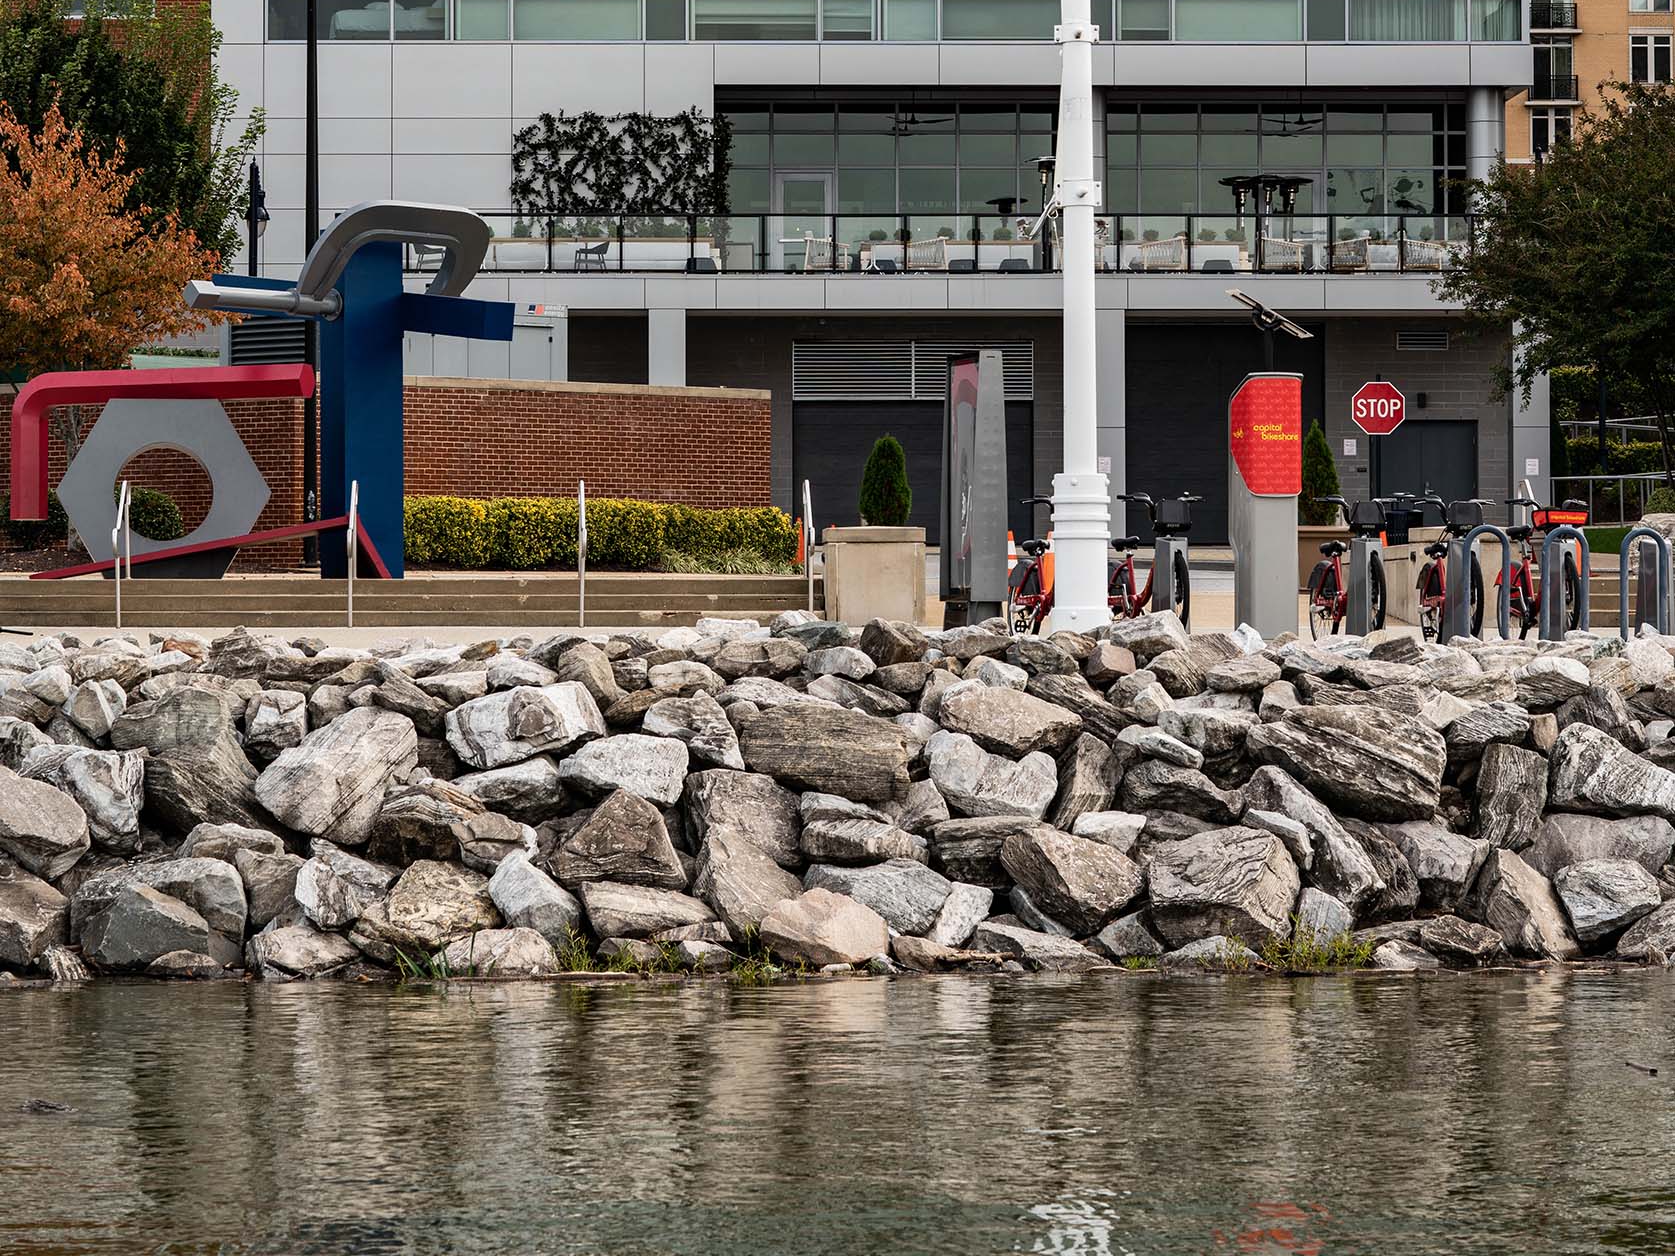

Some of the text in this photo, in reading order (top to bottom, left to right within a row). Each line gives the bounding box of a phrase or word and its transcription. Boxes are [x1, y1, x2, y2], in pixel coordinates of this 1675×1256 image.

[1356, 398, 1401, 418] STOP
[1253, 424, 1282, 433] capital
[1261, 431, 1299, 441] bikeshare
